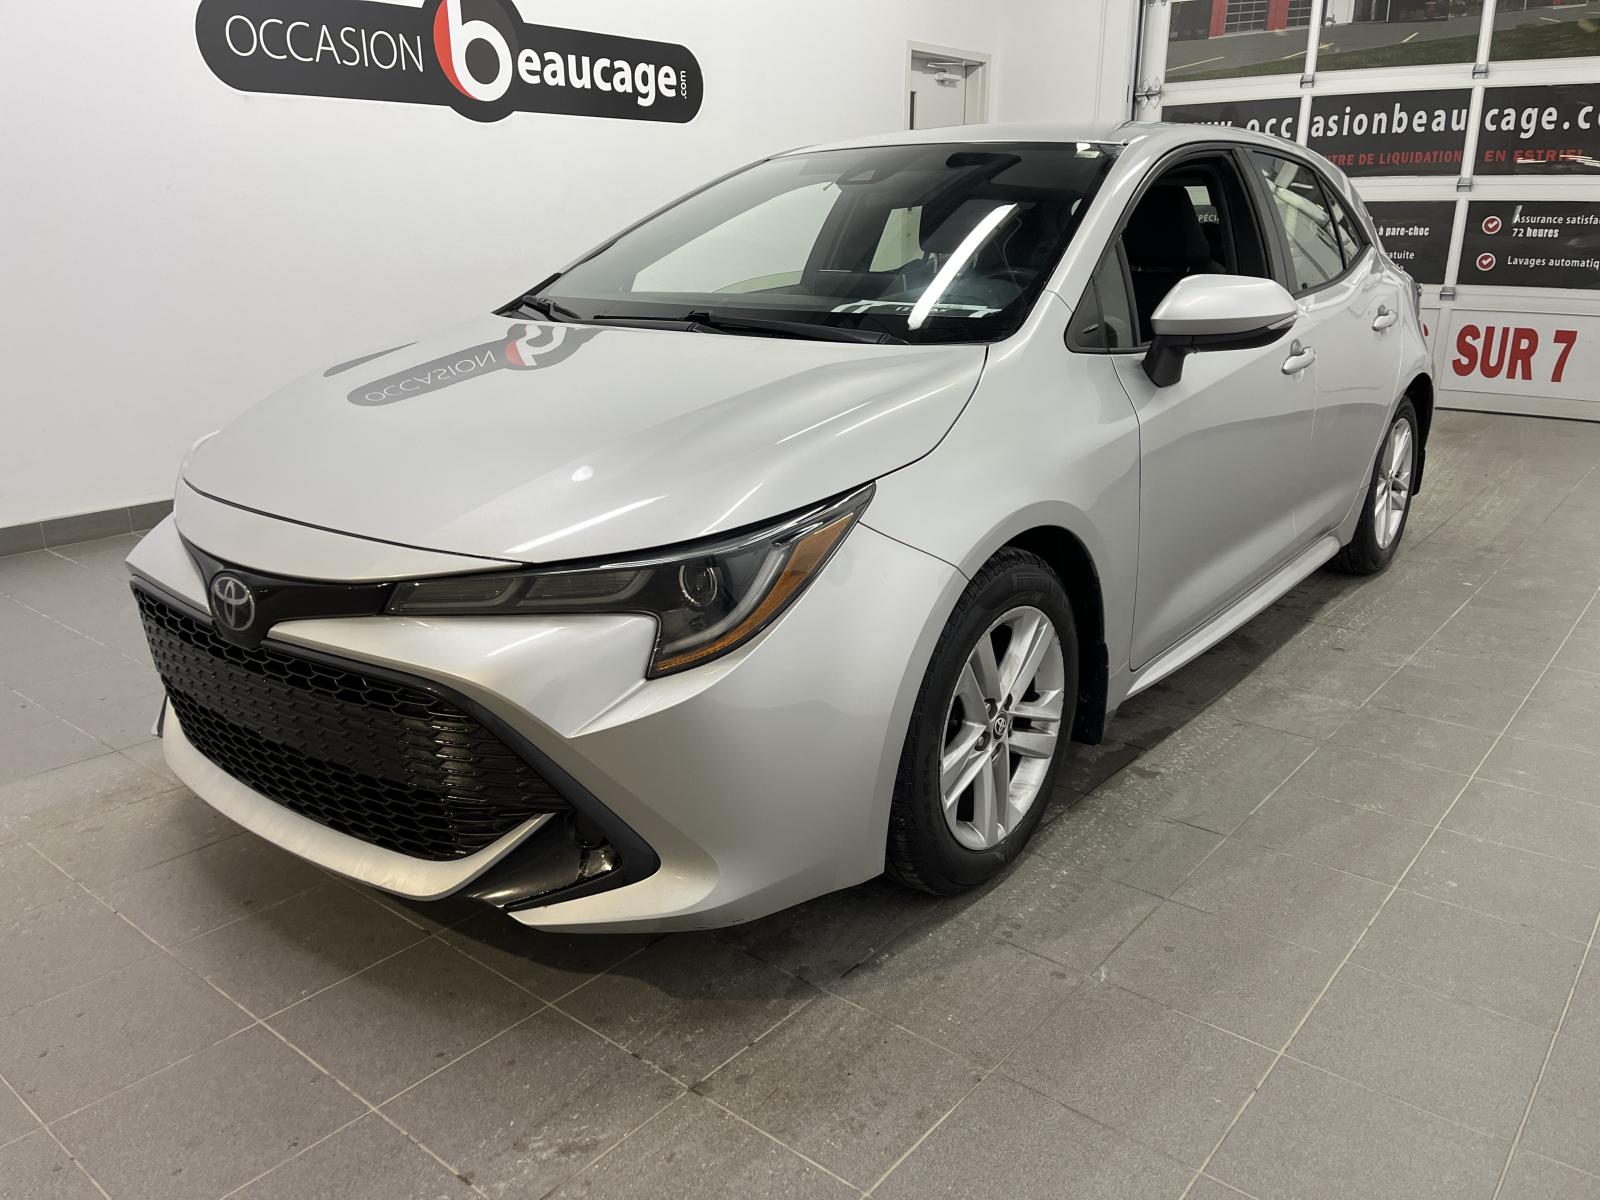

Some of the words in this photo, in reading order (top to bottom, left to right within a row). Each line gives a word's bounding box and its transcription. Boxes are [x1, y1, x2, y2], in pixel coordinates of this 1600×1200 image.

[225, 15, 424, 73] OCCASION
[1358, 152, 1376, 166] DE
[1379, 150, 1463, 165] LIQUIDATION
[1484, 149, 1507, 162] EN
[1513, 213, 1563, 224] Assurance
[1566, 214, 1600, 225] satisfa
[1385, 225, 1430, 237] pare-choc
[1512, 228, 1524, 237] 72
[1526, 226, 1560, 238] heures
[1386, 250, 1415, 260] atuite
[1507, 255, 1546, 267] Lavages
[1452, 324, 1539, 382] SUR
[1551, 330, 1578, 383] 7
